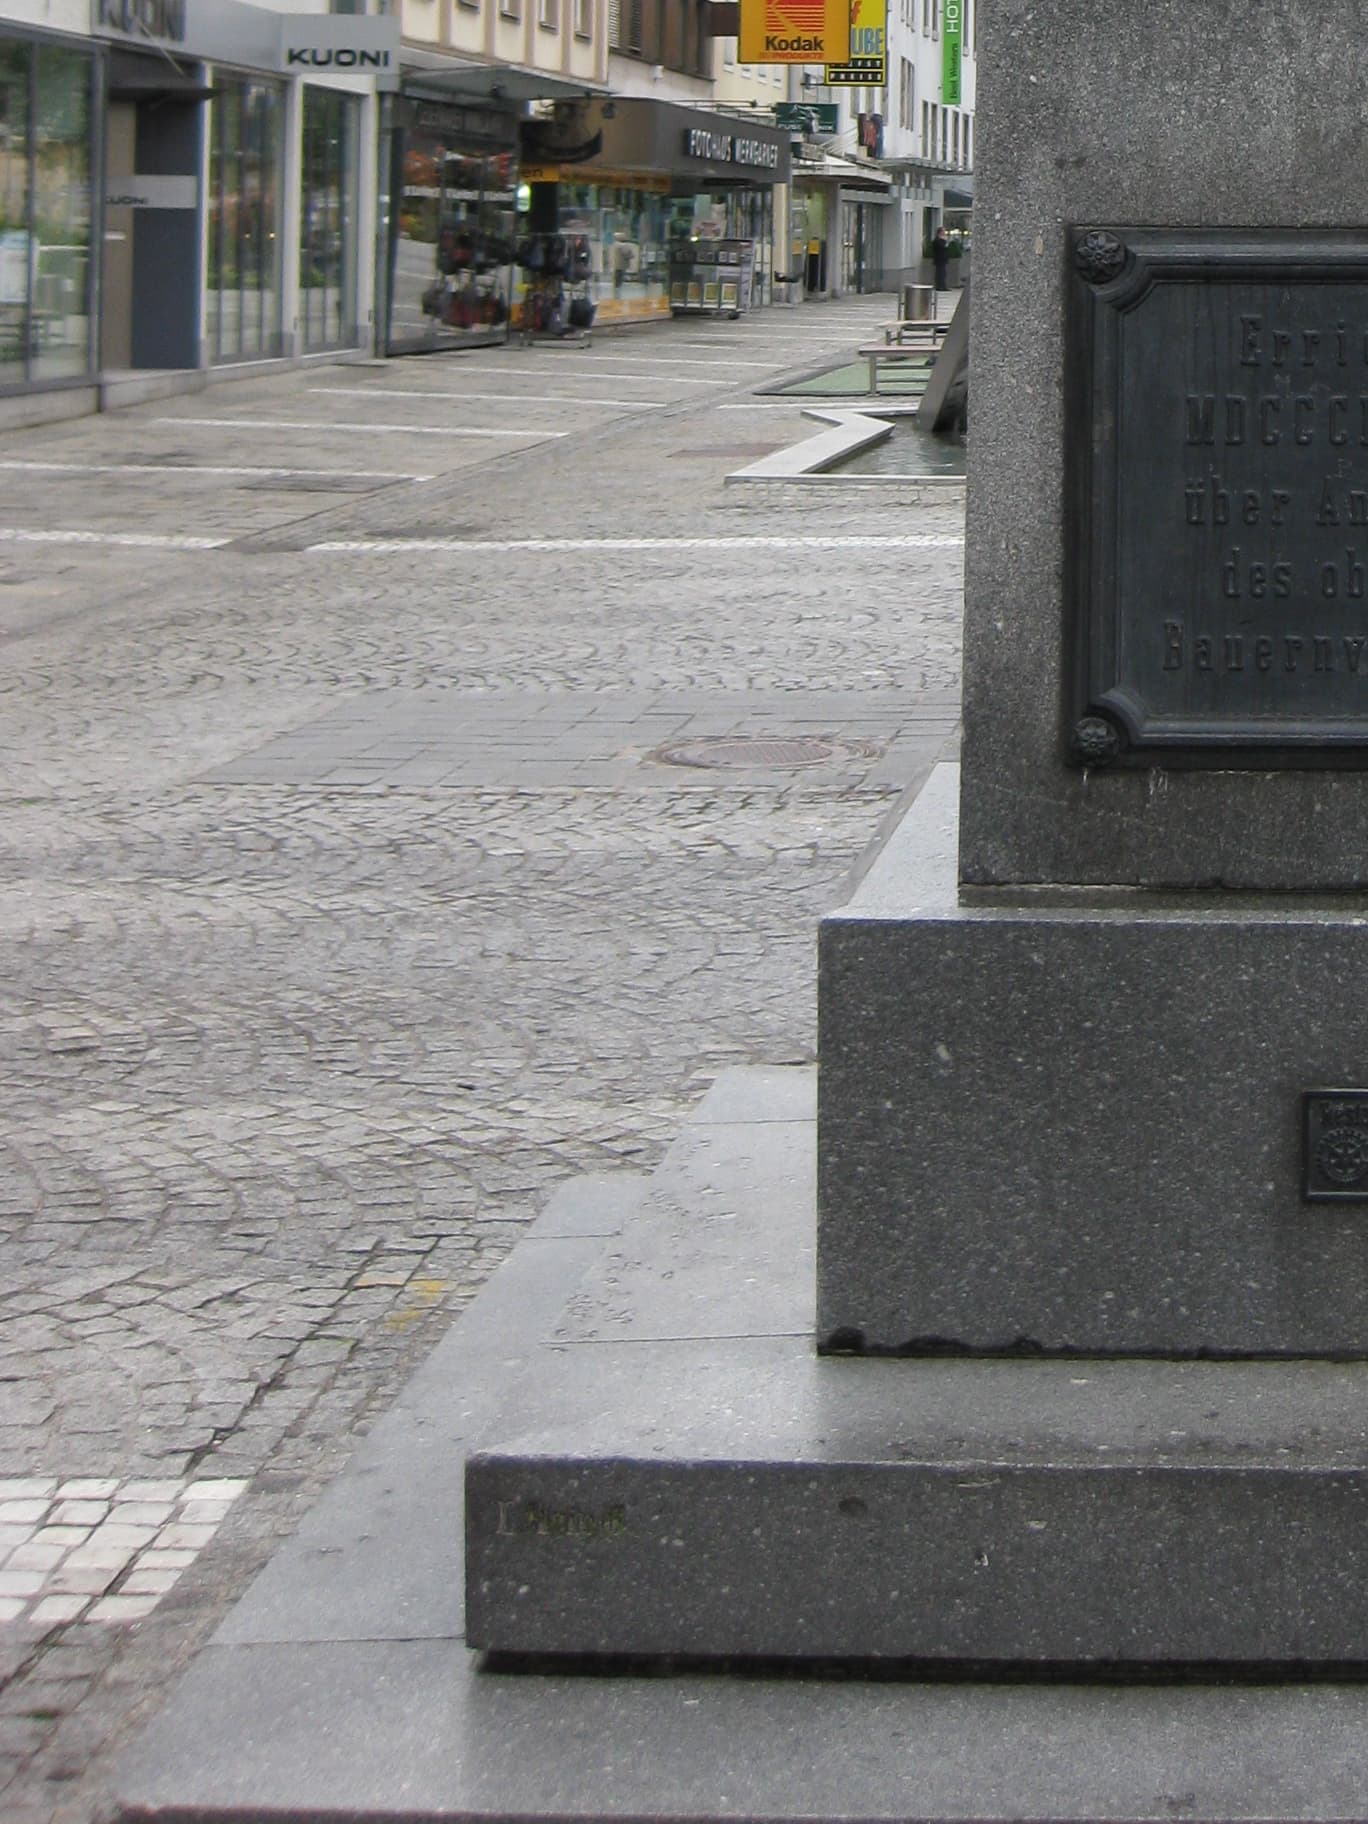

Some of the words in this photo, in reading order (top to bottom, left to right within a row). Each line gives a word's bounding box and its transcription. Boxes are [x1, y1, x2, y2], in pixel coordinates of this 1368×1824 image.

[288, 48, 390, 67] KUONI
[765, 35, 824, 52] Kodak
[1185, 476, 1291, 526] über
[1223, 547, 1292, 598] des
